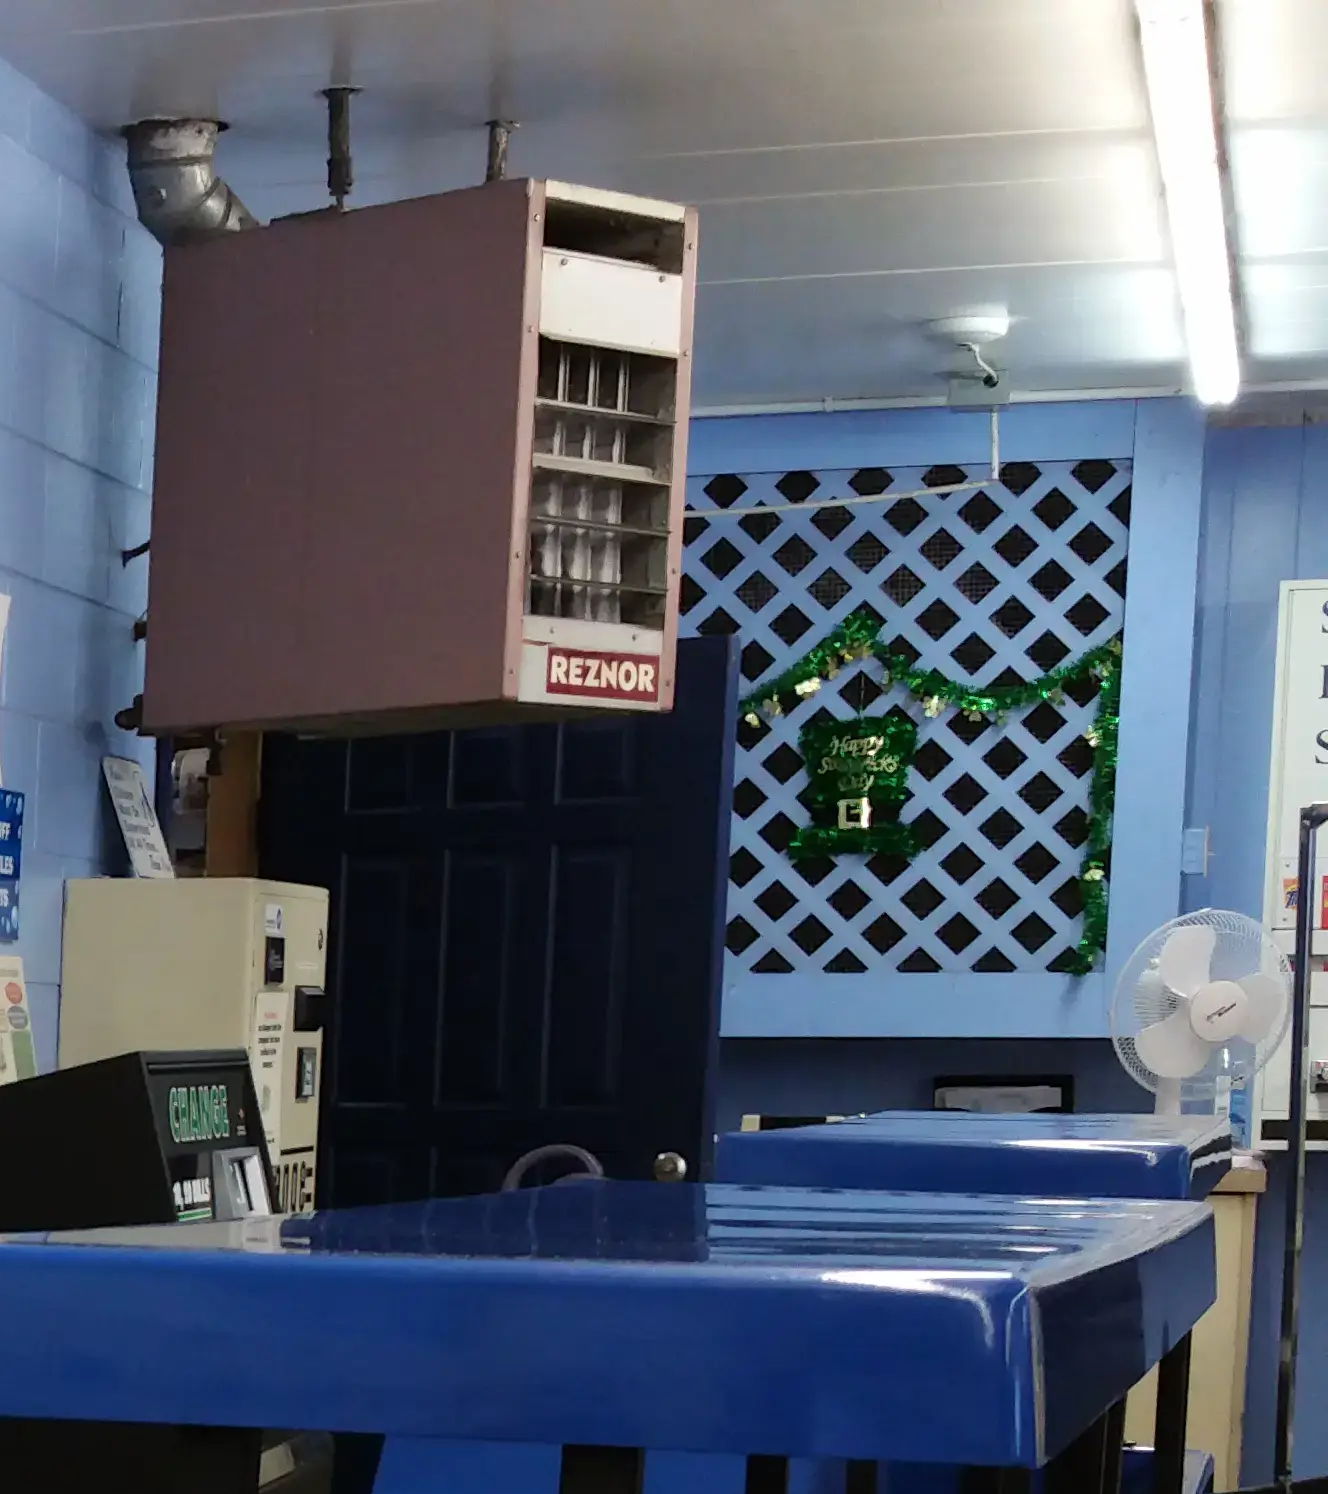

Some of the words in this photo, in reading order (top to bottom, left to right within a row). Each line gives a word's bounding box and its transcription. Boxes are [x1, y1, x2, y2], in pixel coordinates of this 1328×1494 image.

[550, 654, 656, 693] REZNOR
[830, 735, 885, 757] Happy
[169, 1085, 230, 1143] CHANGE
